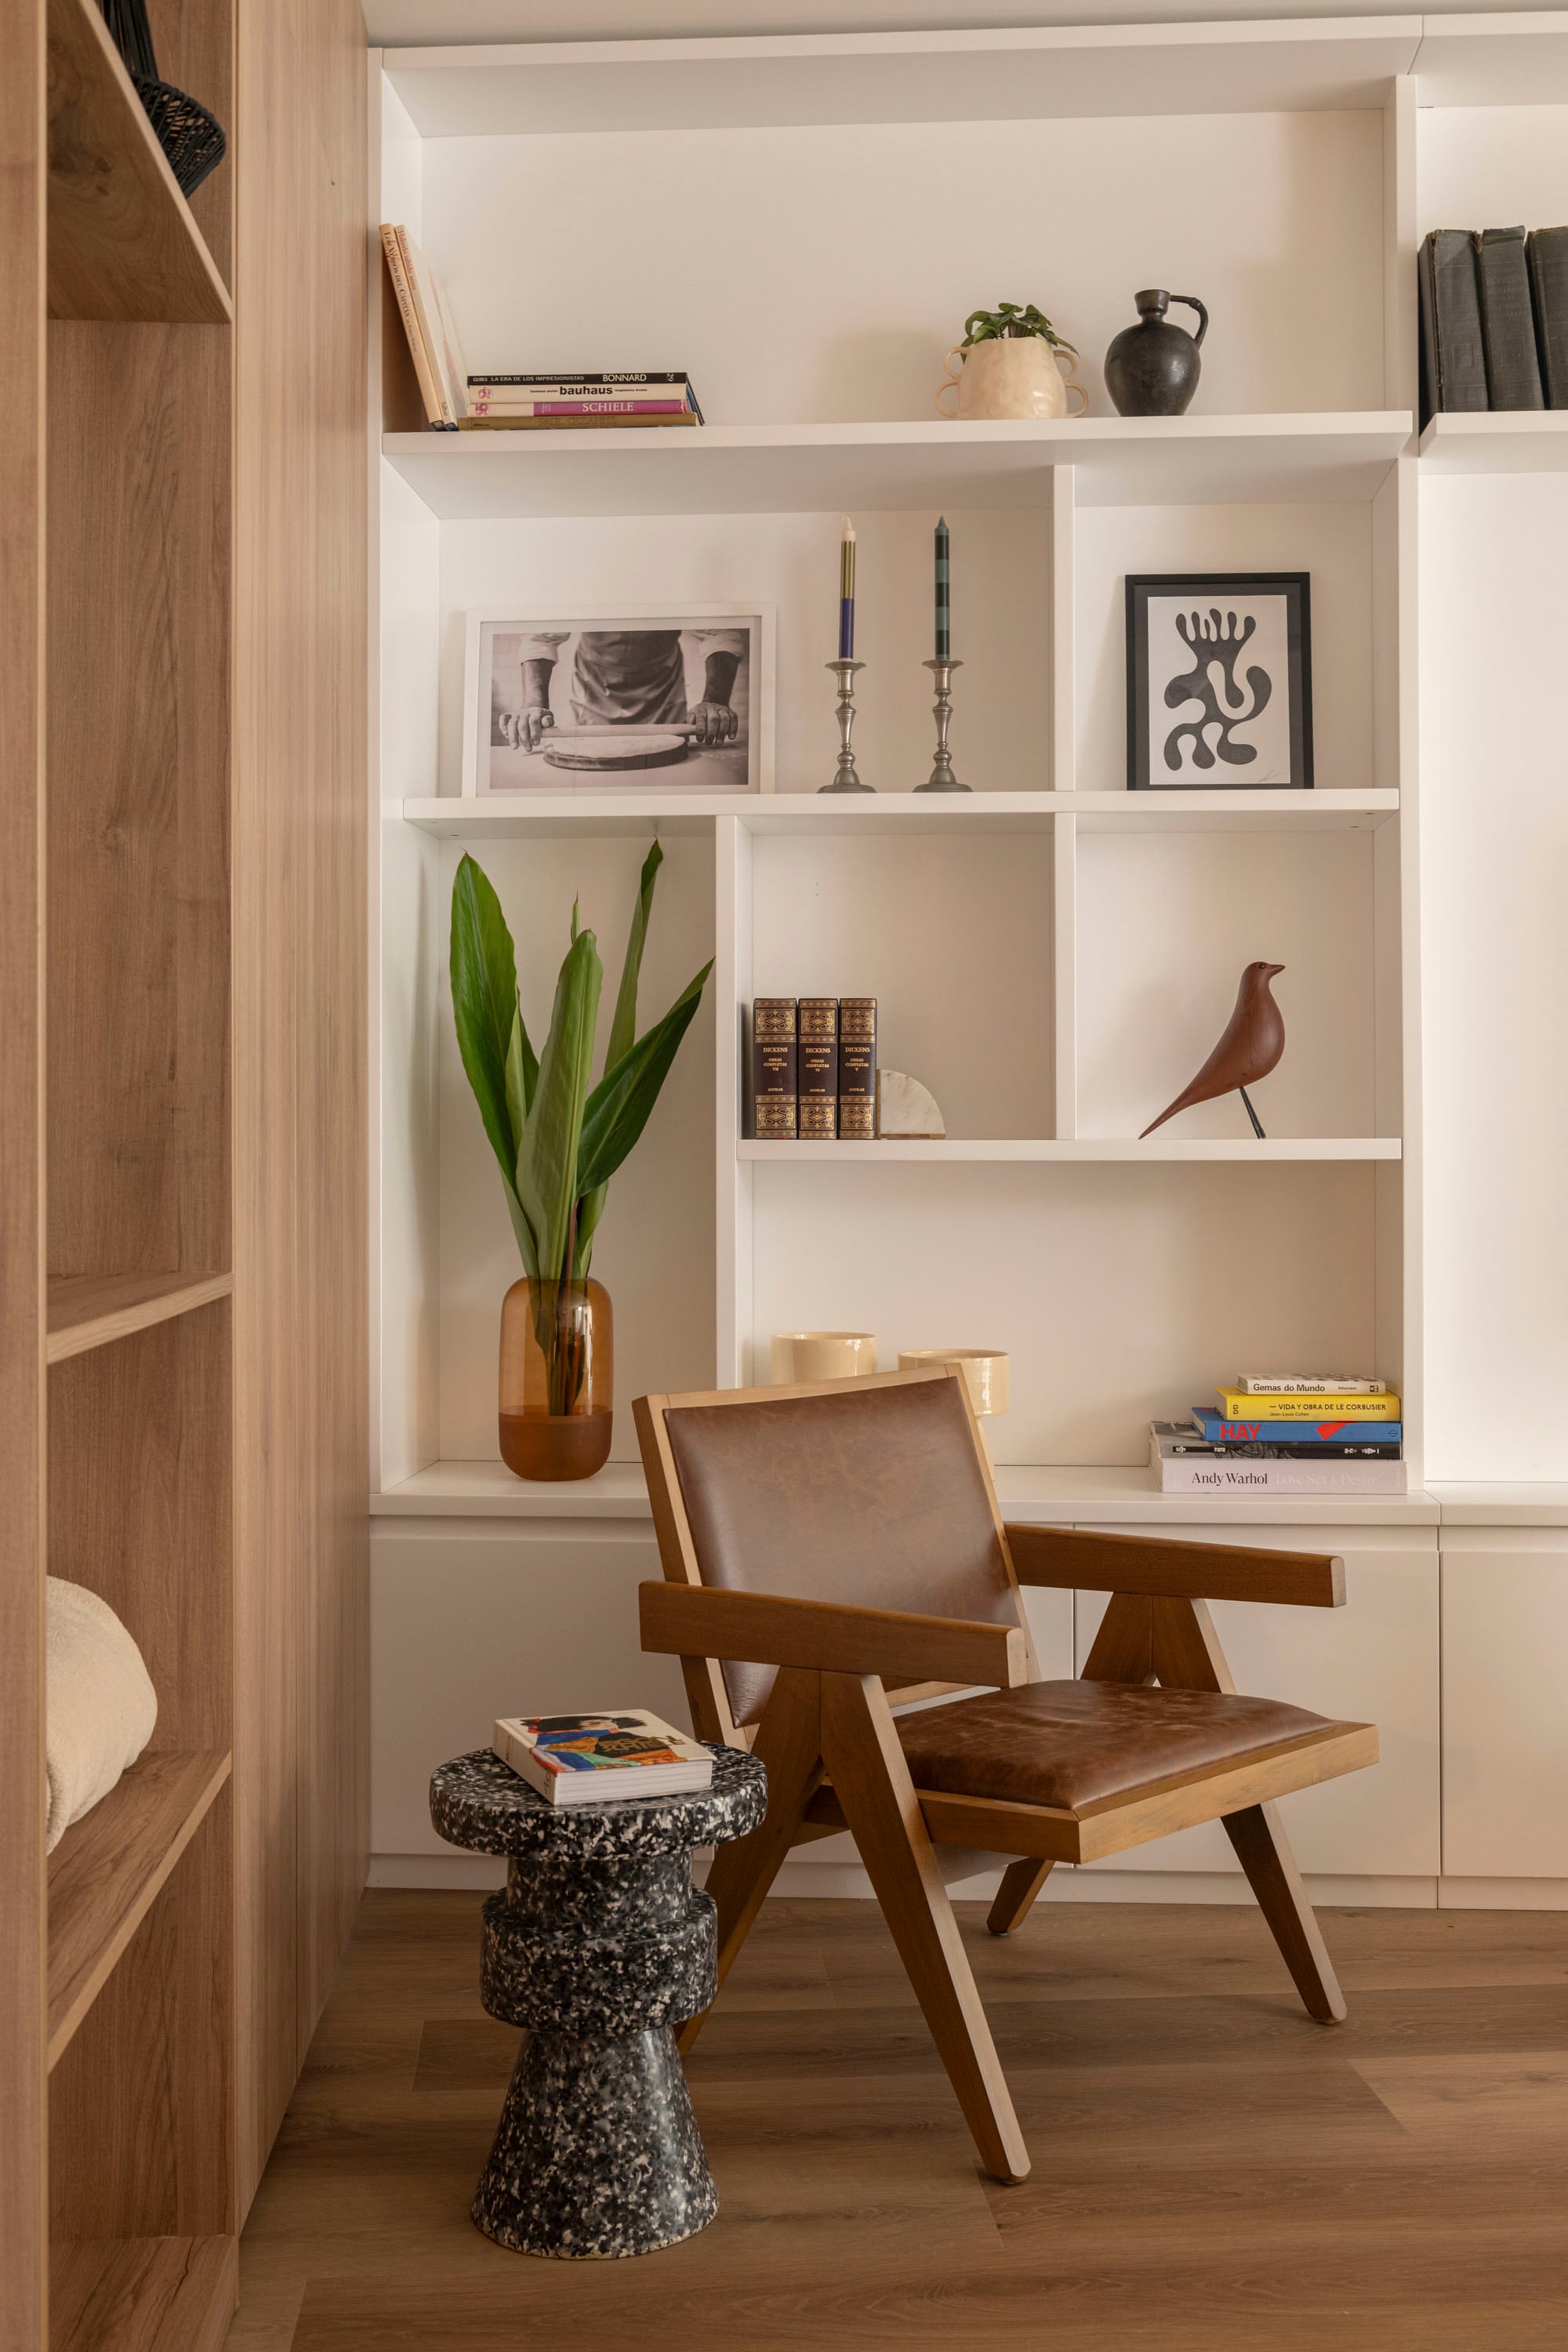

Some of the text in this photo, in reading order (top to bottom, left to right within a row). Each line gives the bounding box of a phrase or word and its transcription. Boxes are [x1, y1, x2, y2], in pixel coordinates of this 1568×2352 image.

[560, 386, 612, 395] bauhaus
[583, 401, 633, 412] SCHIELE
[1233, 1404, 1238, 1415] GG
[1220, 1424, 1261, 1441] HAY
[1192, 1472, 1268, 1486] Andy Warhol
[1276, 1474, 1303, 1484] Love
[1306, 1474, 1327, 1484] Sex
[1341, 1474, 1378, 1485] Desire
